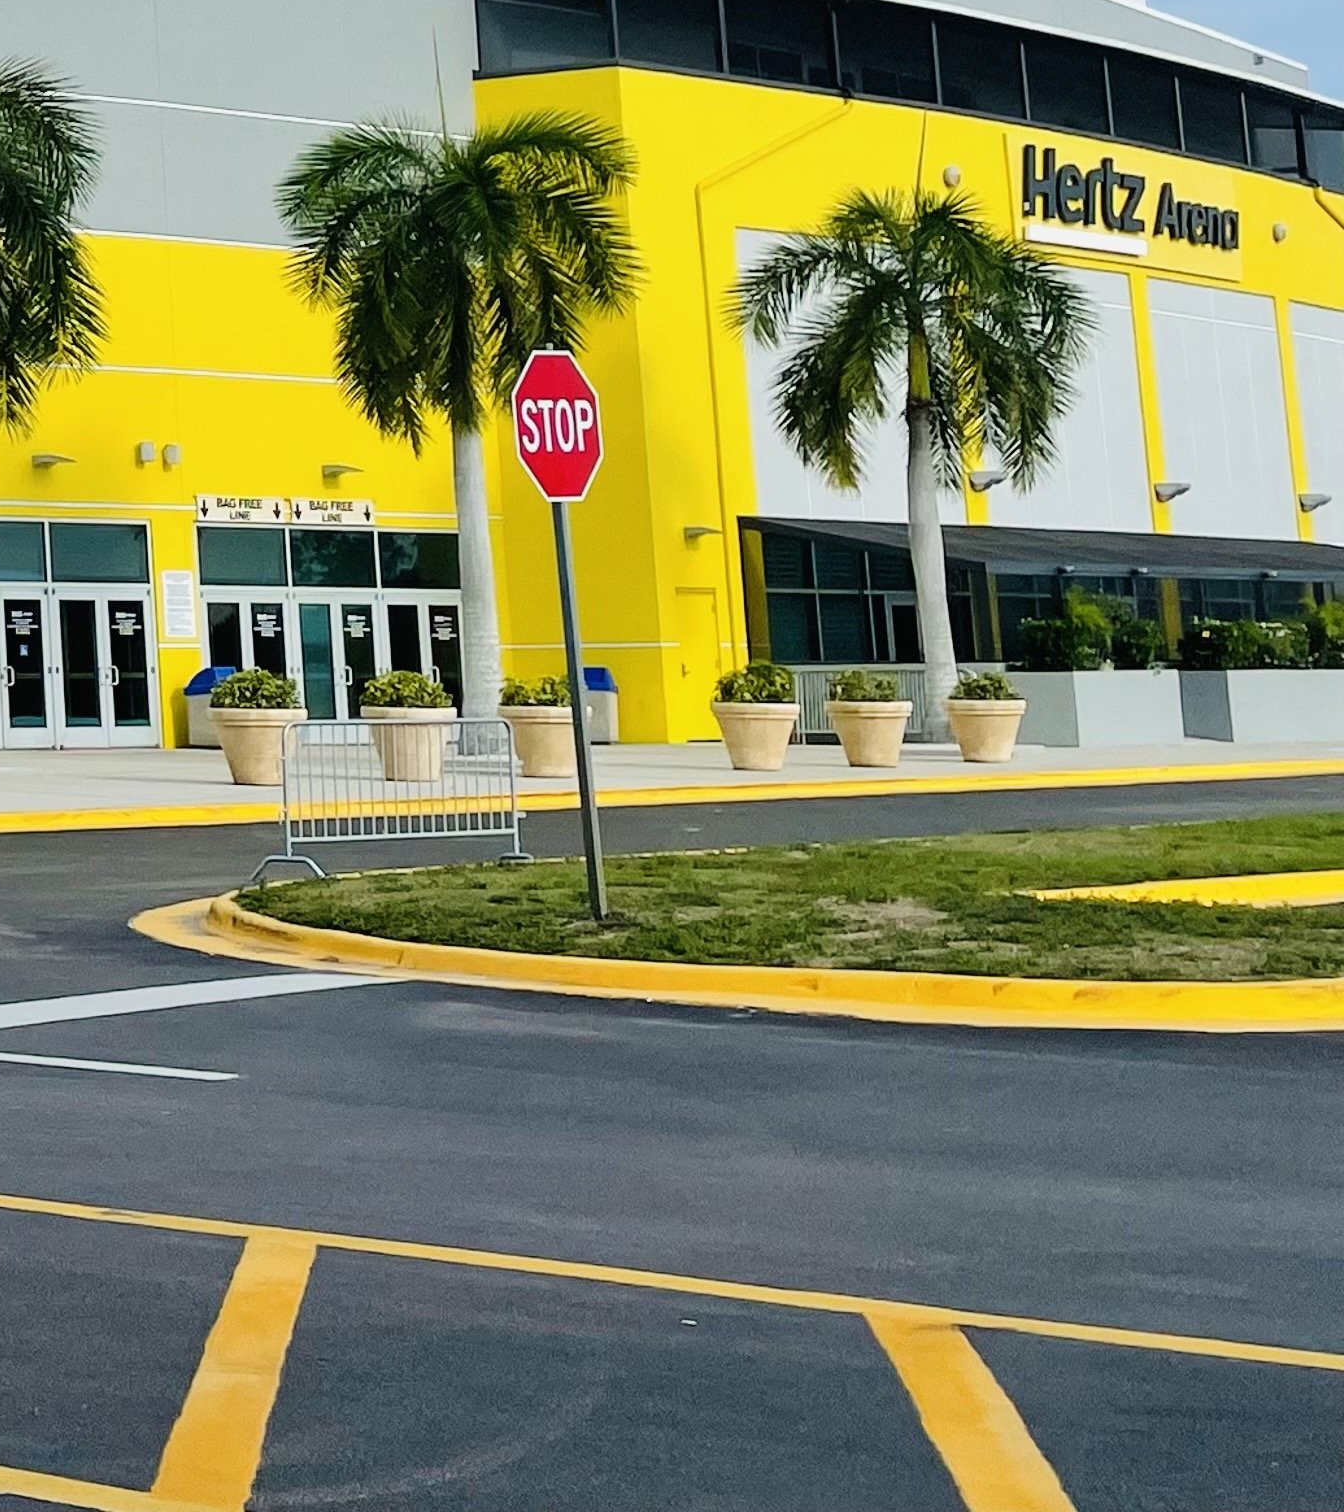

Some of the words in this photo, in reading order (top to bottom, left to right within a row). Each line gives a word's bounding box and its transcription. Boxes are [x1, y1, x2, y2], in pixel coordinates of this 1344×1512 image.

[1022, 144, 1145, 233] Hertz
[1153, 182, 1239, 250] Arena
[521, 398, 594, 453] STOP
[216, 497, 236, 508] BAG
[238, 499, 262, 509] FREE
[309, 500, 328, 511] BAG
[330, 501, 354, 512] FREE
[229, 510, 251, 520] LINE
[322, 513, 342, 523] LINE
